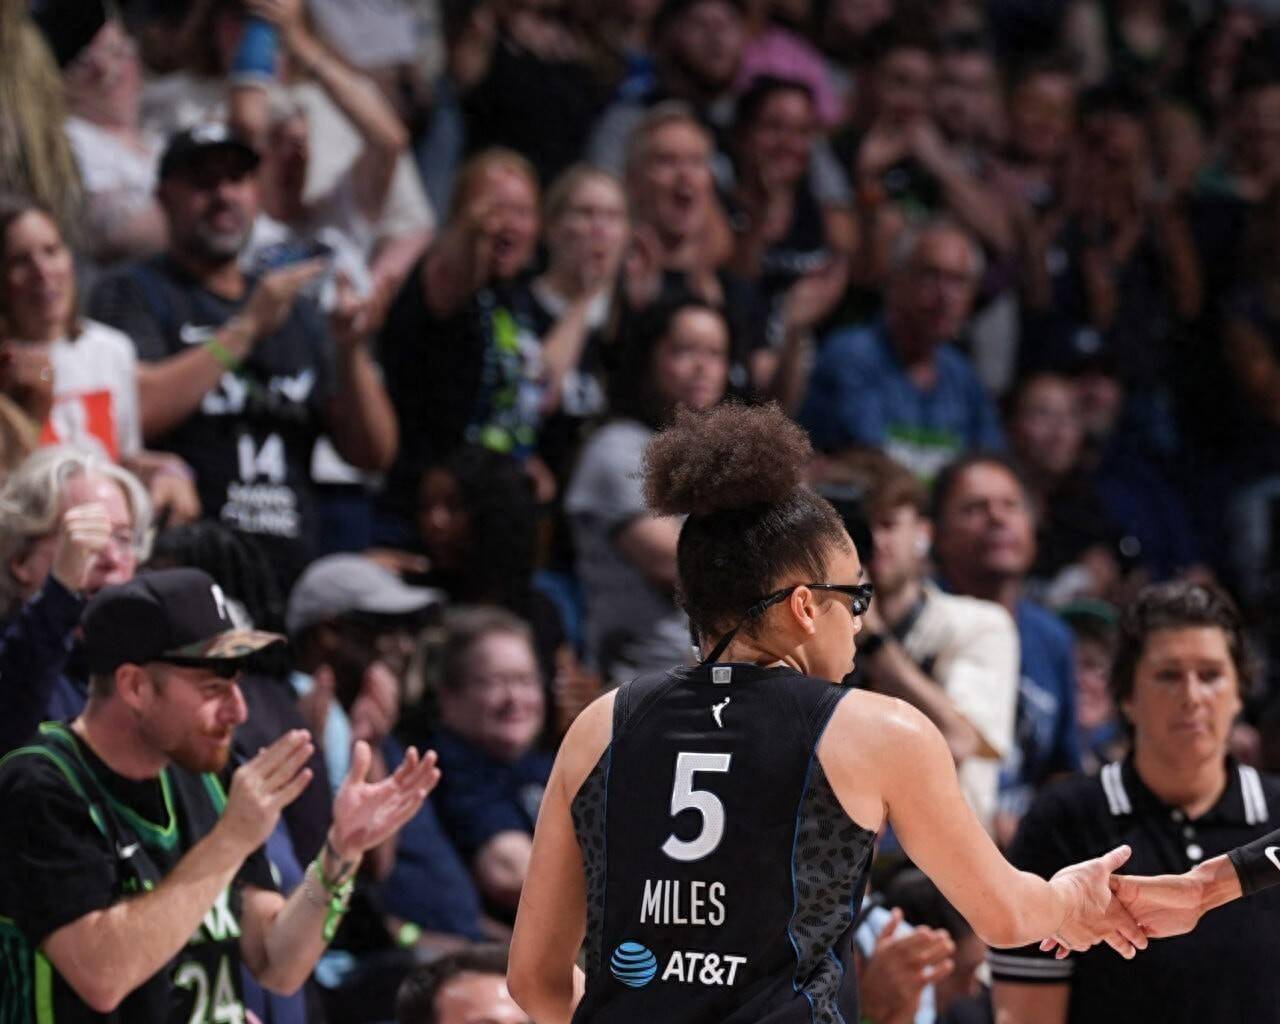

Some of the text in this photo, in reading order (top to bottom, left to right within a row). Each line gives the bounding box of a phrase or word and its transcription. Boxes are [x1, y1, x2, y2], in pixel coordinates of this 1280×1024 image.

[662, 752, 732, 861] 5
[640, 879, 727, 927] MILES
[661, 950, 747, 987] AT&T
